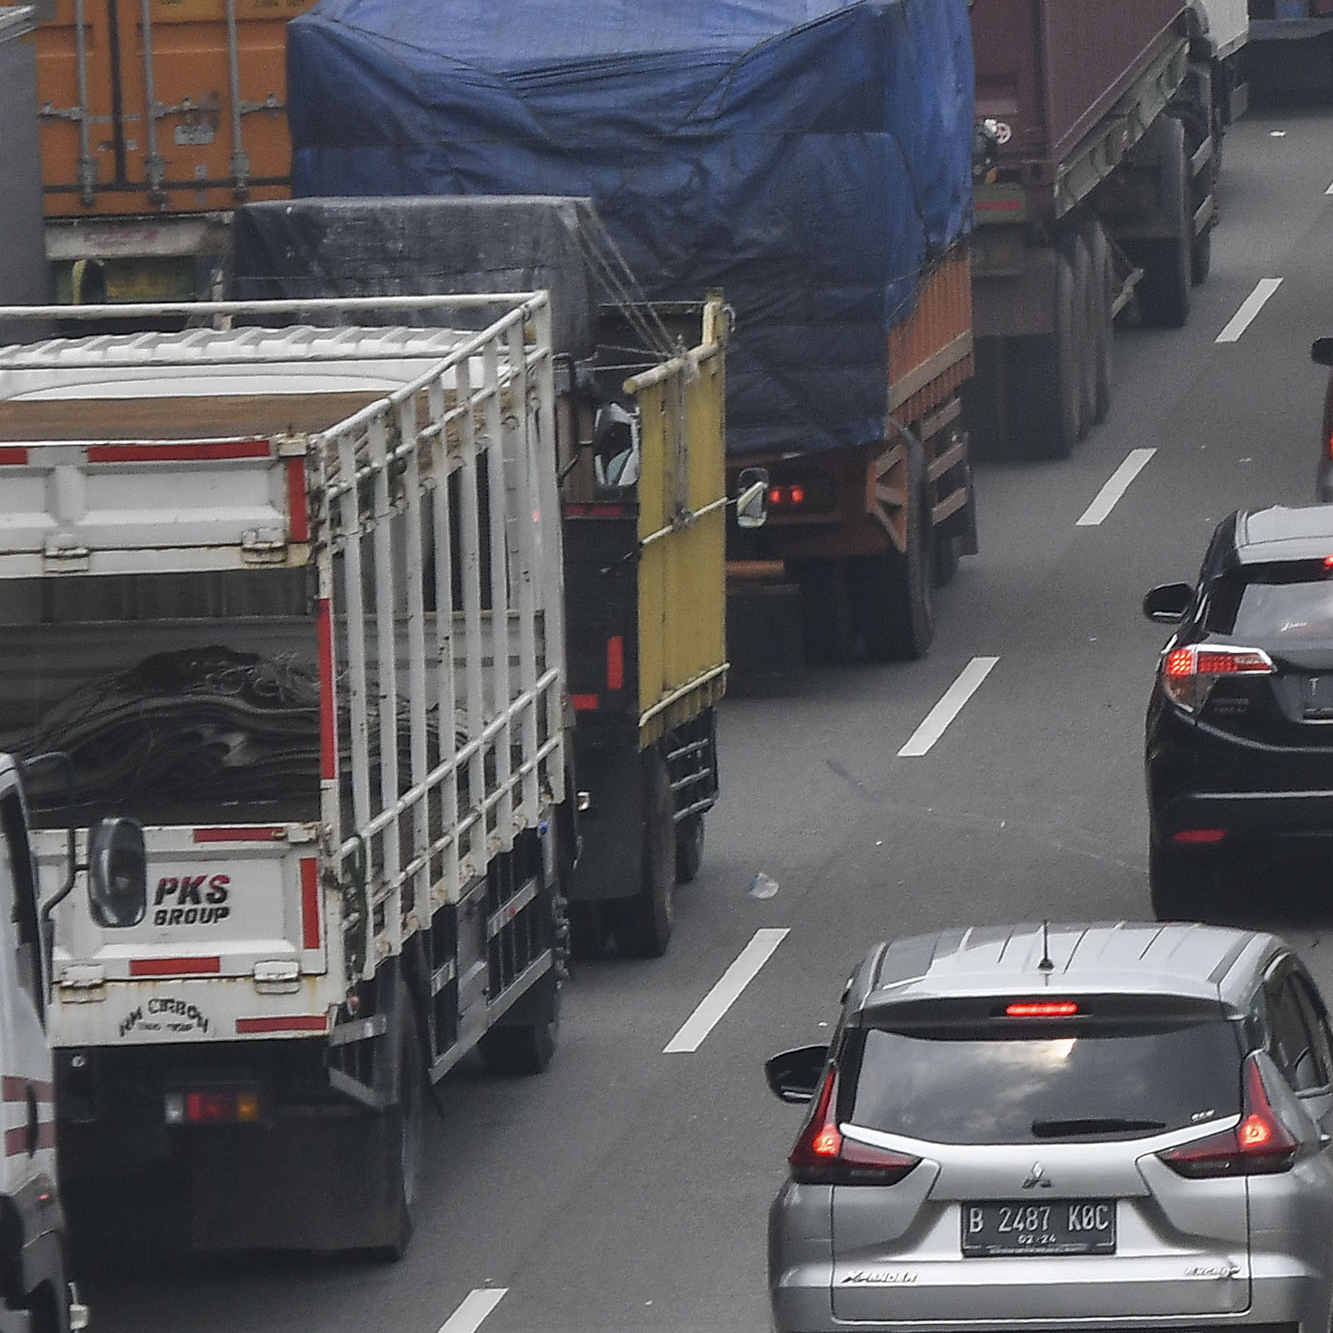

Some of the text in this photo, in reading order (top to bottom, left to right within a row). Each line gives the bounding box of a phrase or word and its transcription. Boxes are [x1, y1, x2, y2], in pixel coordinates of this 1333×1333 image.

[153, 874, 232, 906] PKS
[153, 906, 231, 927] GROUP
[969, 1207, 984, 1233] B
[997, 1205, 1052, 1233] 2487
